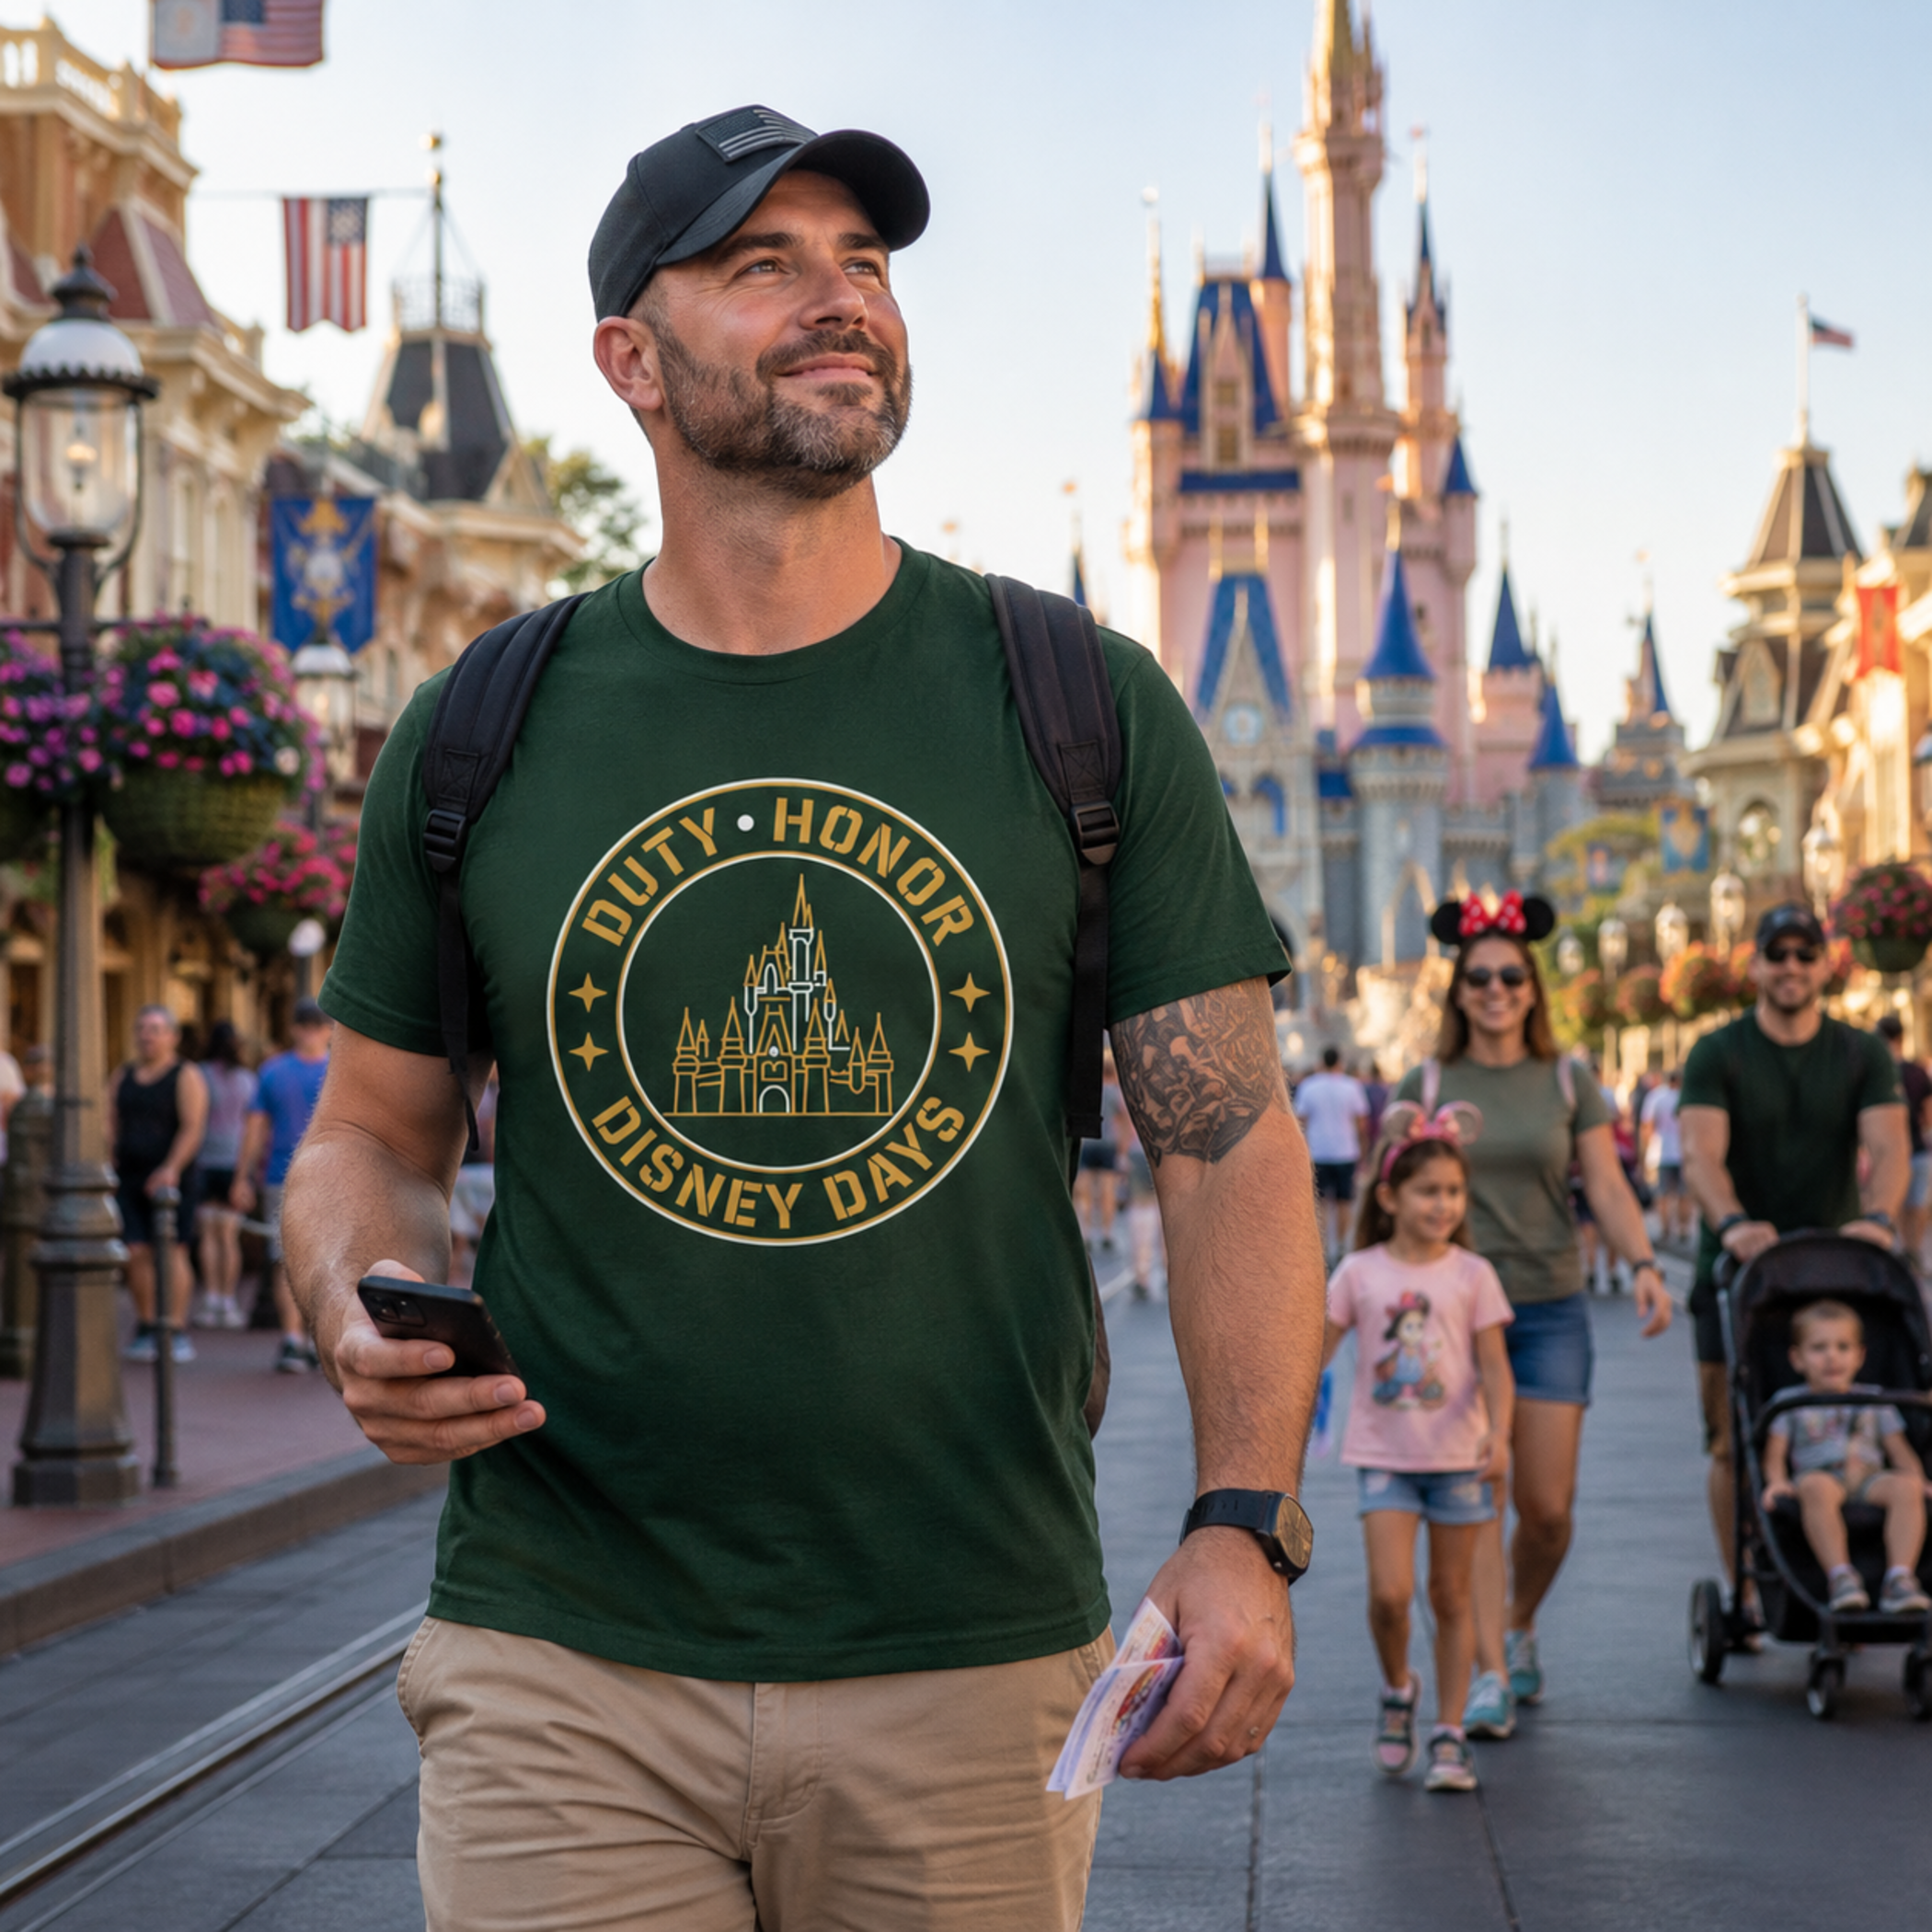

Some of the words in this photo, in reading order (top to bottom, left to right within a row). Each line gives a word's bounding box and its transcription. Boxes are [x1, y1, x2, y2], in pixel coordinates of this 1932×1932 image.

[581, 807, 718, 947] DUTY
[773, 798, 974, 947] HONOR
[592, 1096, 803, 1229] DISNEY
[822, 1096, 965, 1221] DAYS
